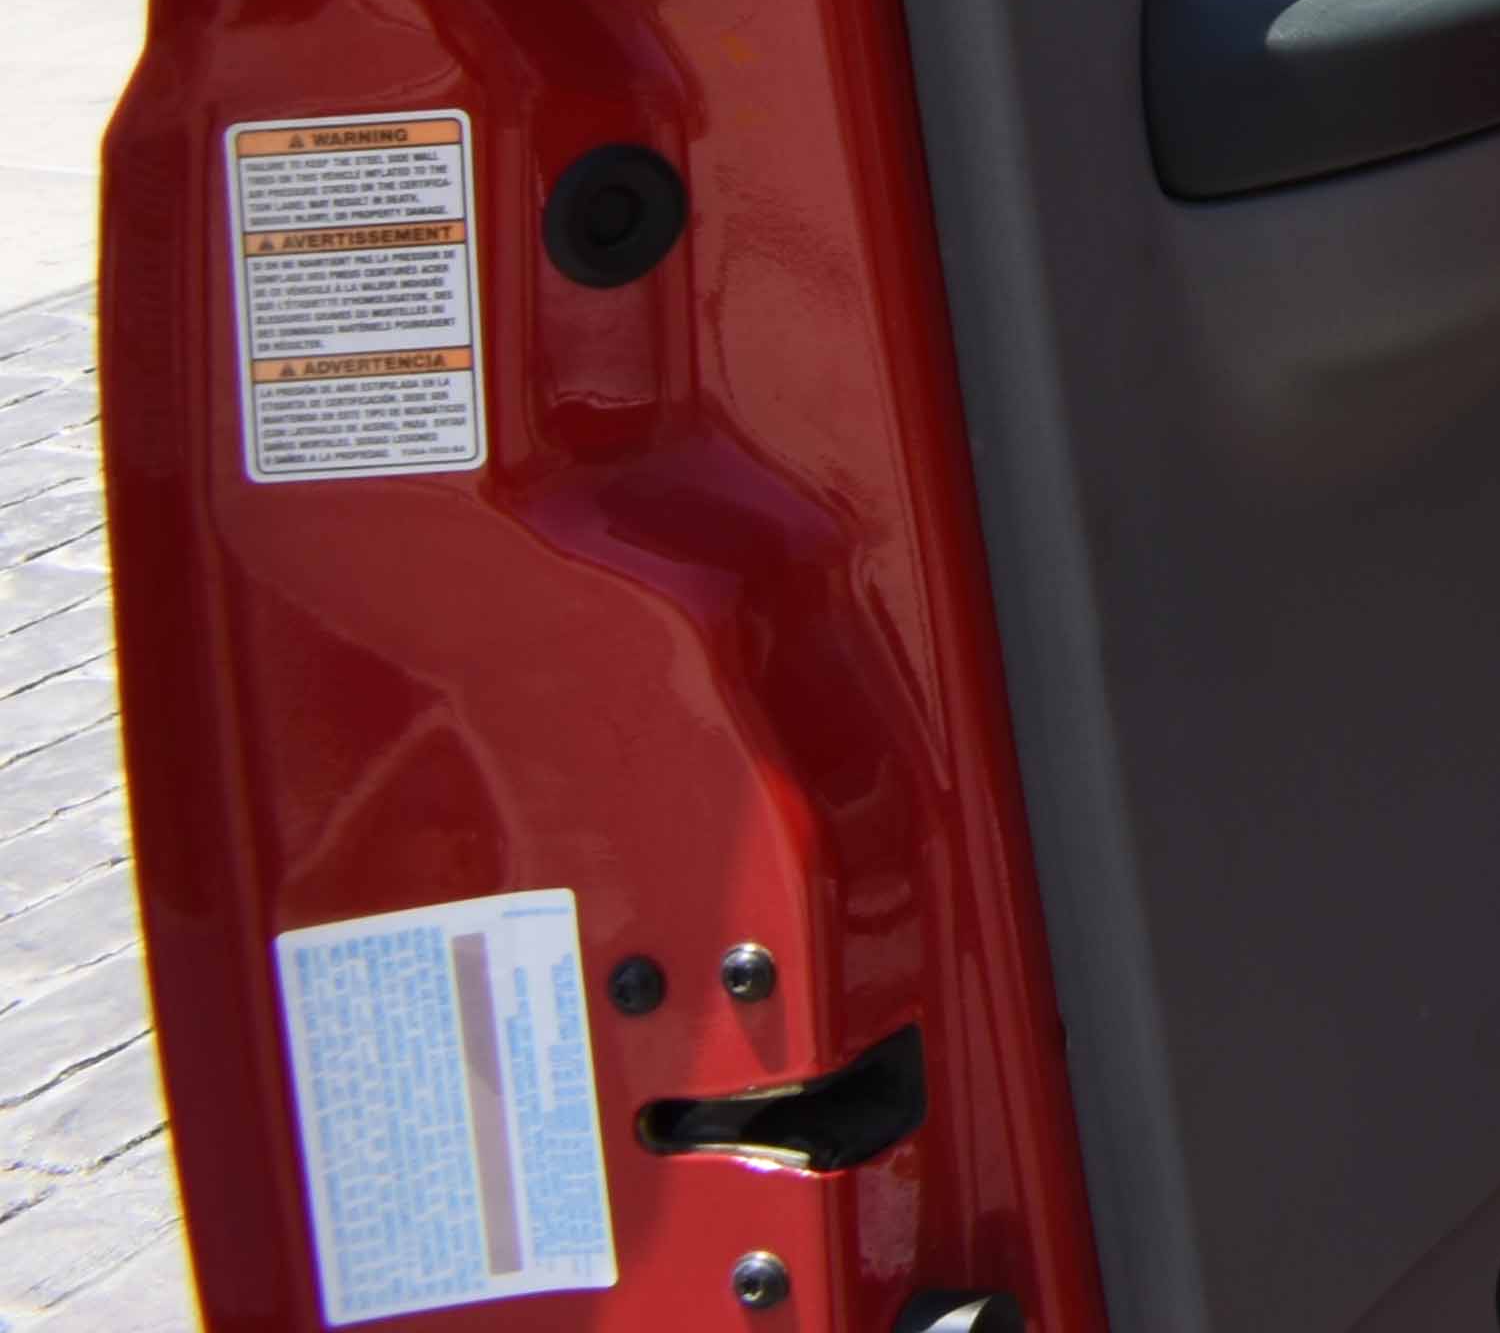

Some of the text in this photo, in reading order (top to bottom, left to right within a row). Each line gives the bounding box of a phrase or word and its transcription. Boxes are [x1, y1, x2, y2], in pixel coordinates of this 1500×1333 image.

[312, 128, 408, 146] WARNING
[282, 225, 452, 248] AVERTISSEMENT
[303, 354, 446, 374] ADVERTENCIA
